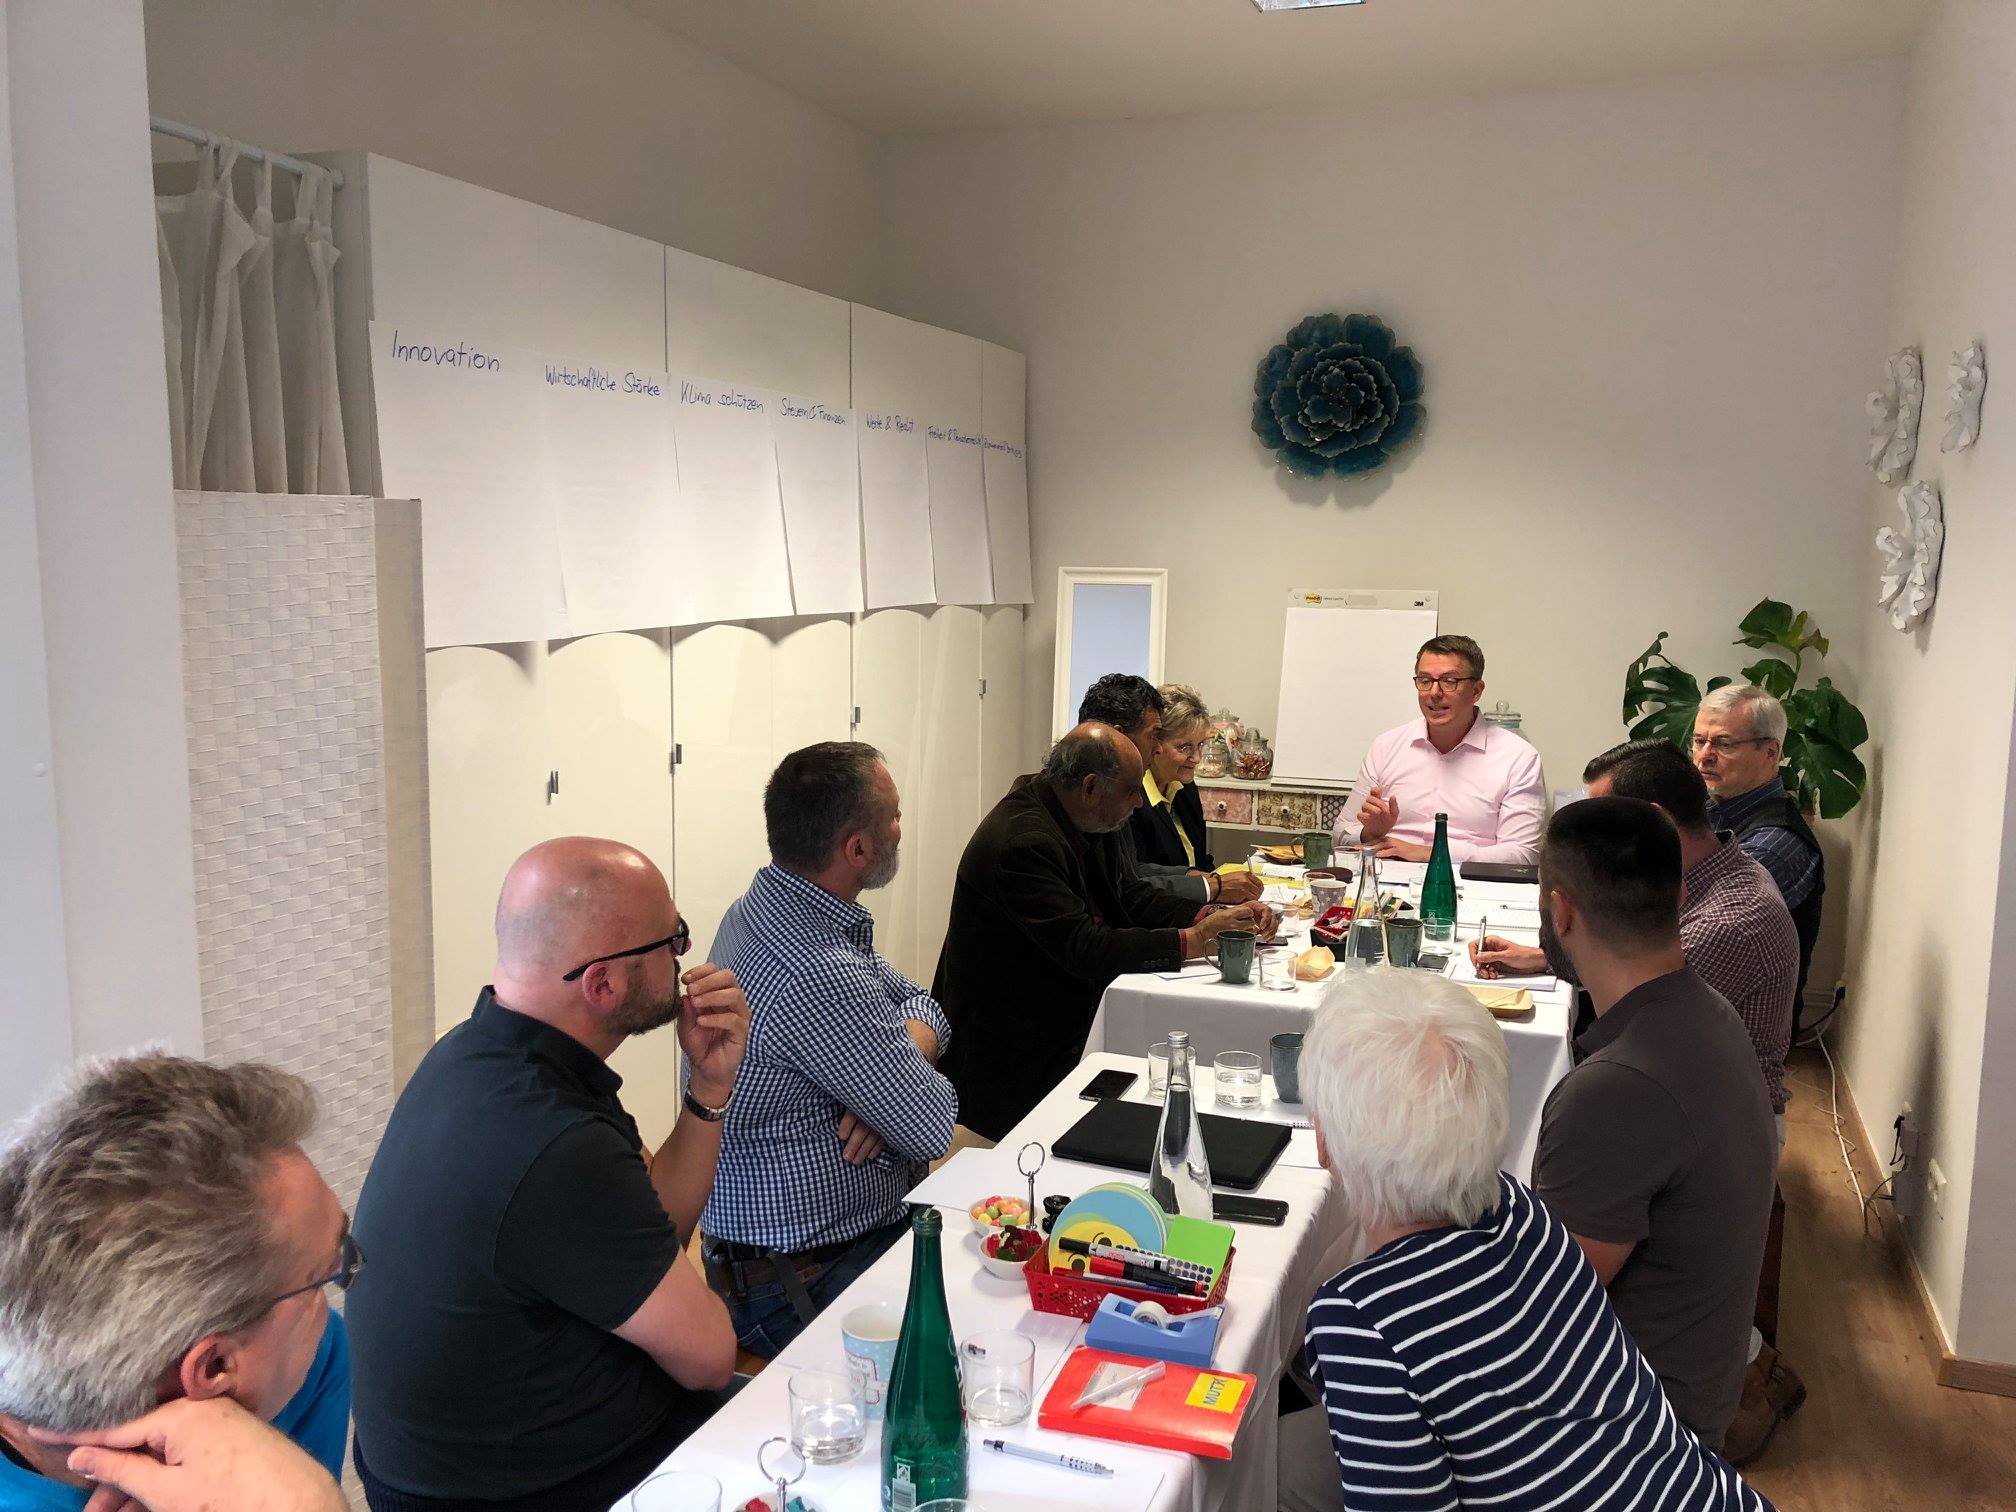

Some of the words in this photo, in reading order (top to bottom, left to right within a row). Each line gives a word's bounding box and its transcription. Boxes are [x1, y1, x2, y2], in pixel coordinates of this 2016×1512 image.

[392, 329, 501, 372] Innovation
[717, 387, 765, 414] schützen
[884, 415, 892, 431] &
